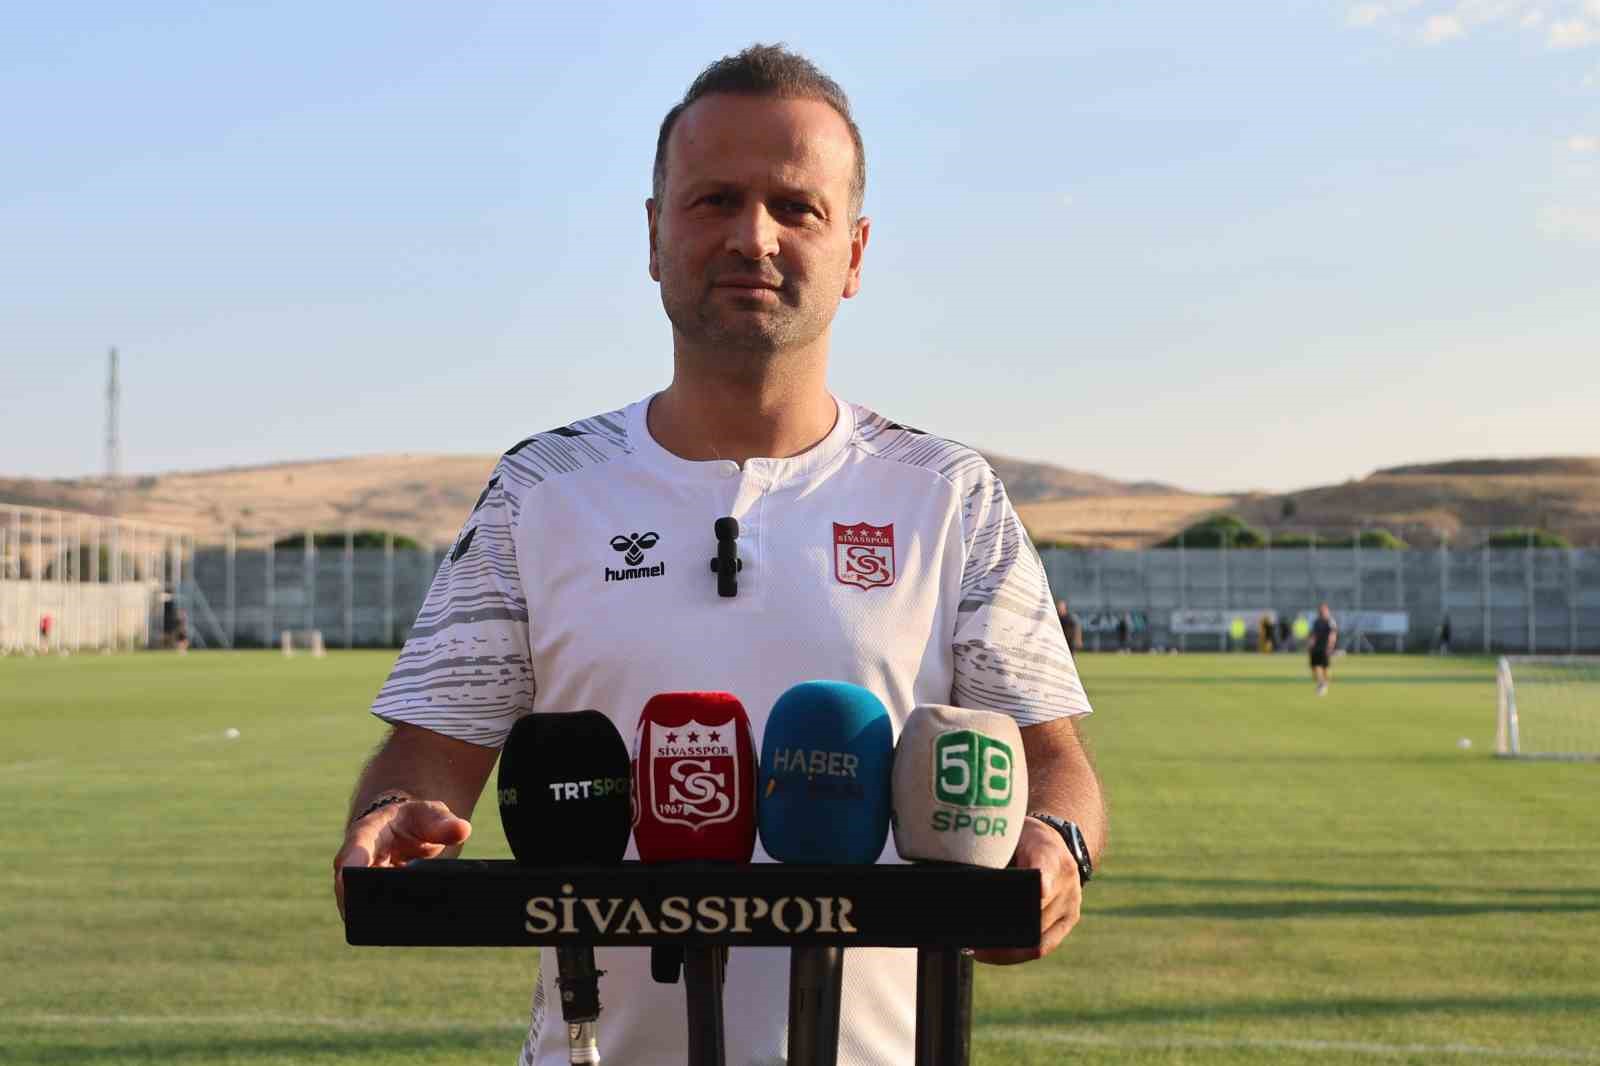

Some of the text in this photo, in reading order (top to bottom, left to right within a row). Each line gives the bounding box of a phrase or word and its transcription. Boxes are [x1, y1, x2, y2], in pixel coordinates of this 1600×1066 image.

[605, 562, 664, 582] hummel
[774, 748, 859, 778] HABER
[941, 743, 1011, 800] 58
[549, 777, 629, 801] TRTSPO
[659, 803, 683, 815] 1967
[932, 810, 1008, 837] SPOR
[525, 883, 857, 934] SİVASSPOR
